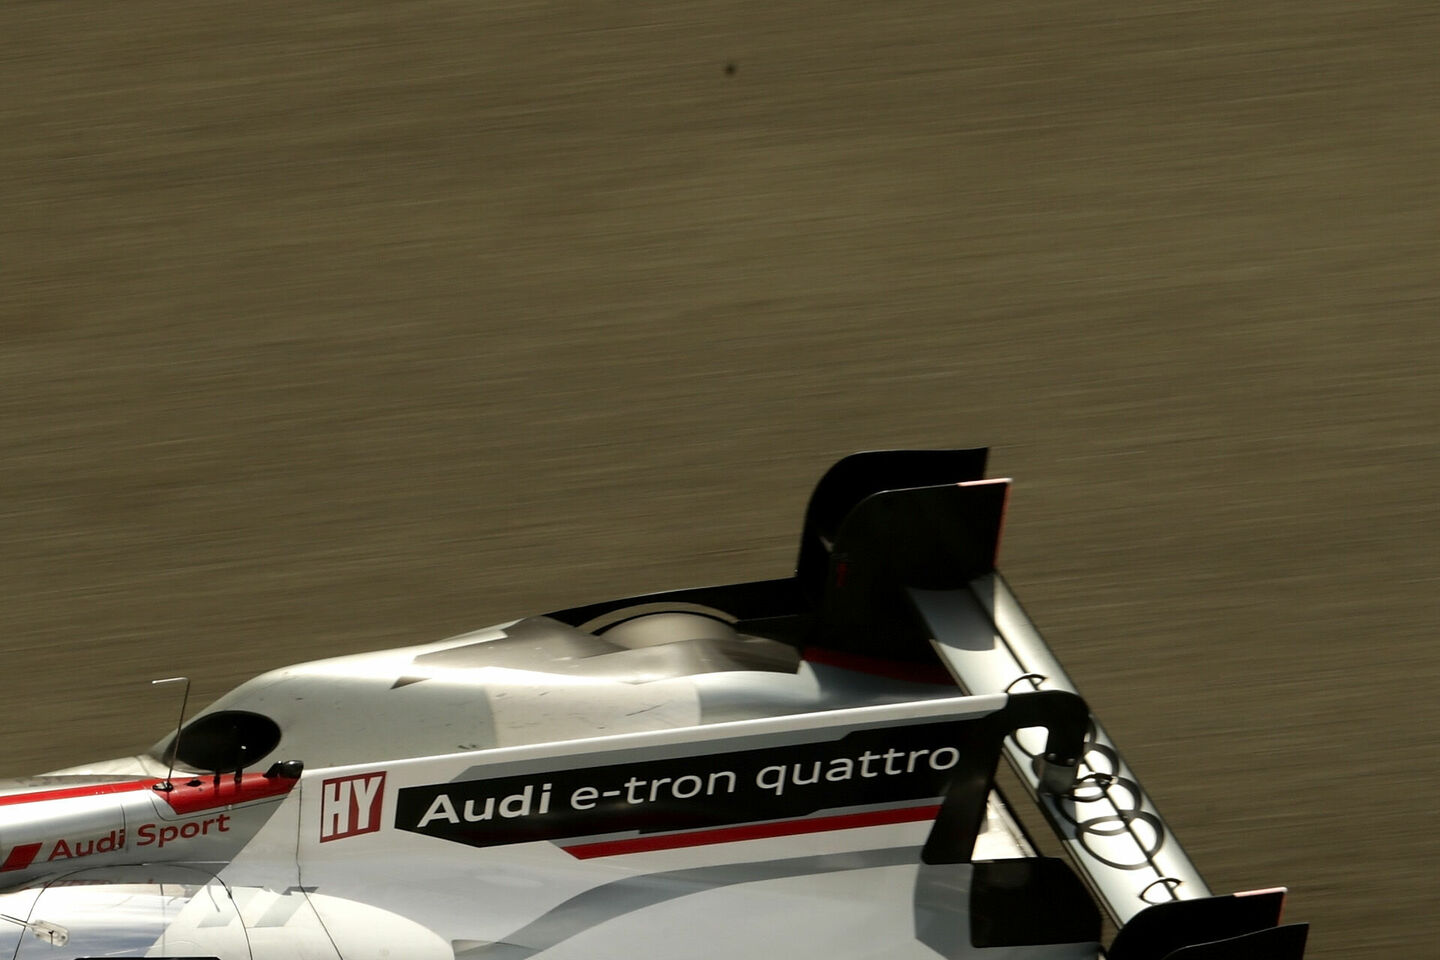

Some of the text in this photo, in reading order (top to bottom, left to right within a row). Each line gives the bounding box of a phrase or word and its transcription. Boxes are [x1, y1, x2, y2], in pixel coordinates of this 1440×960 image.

[322, 775, 383, 838] HY
[417, 745, 960, 828] Audi e-tron quattro
[47, 813, 231, 861] Audi Sport
